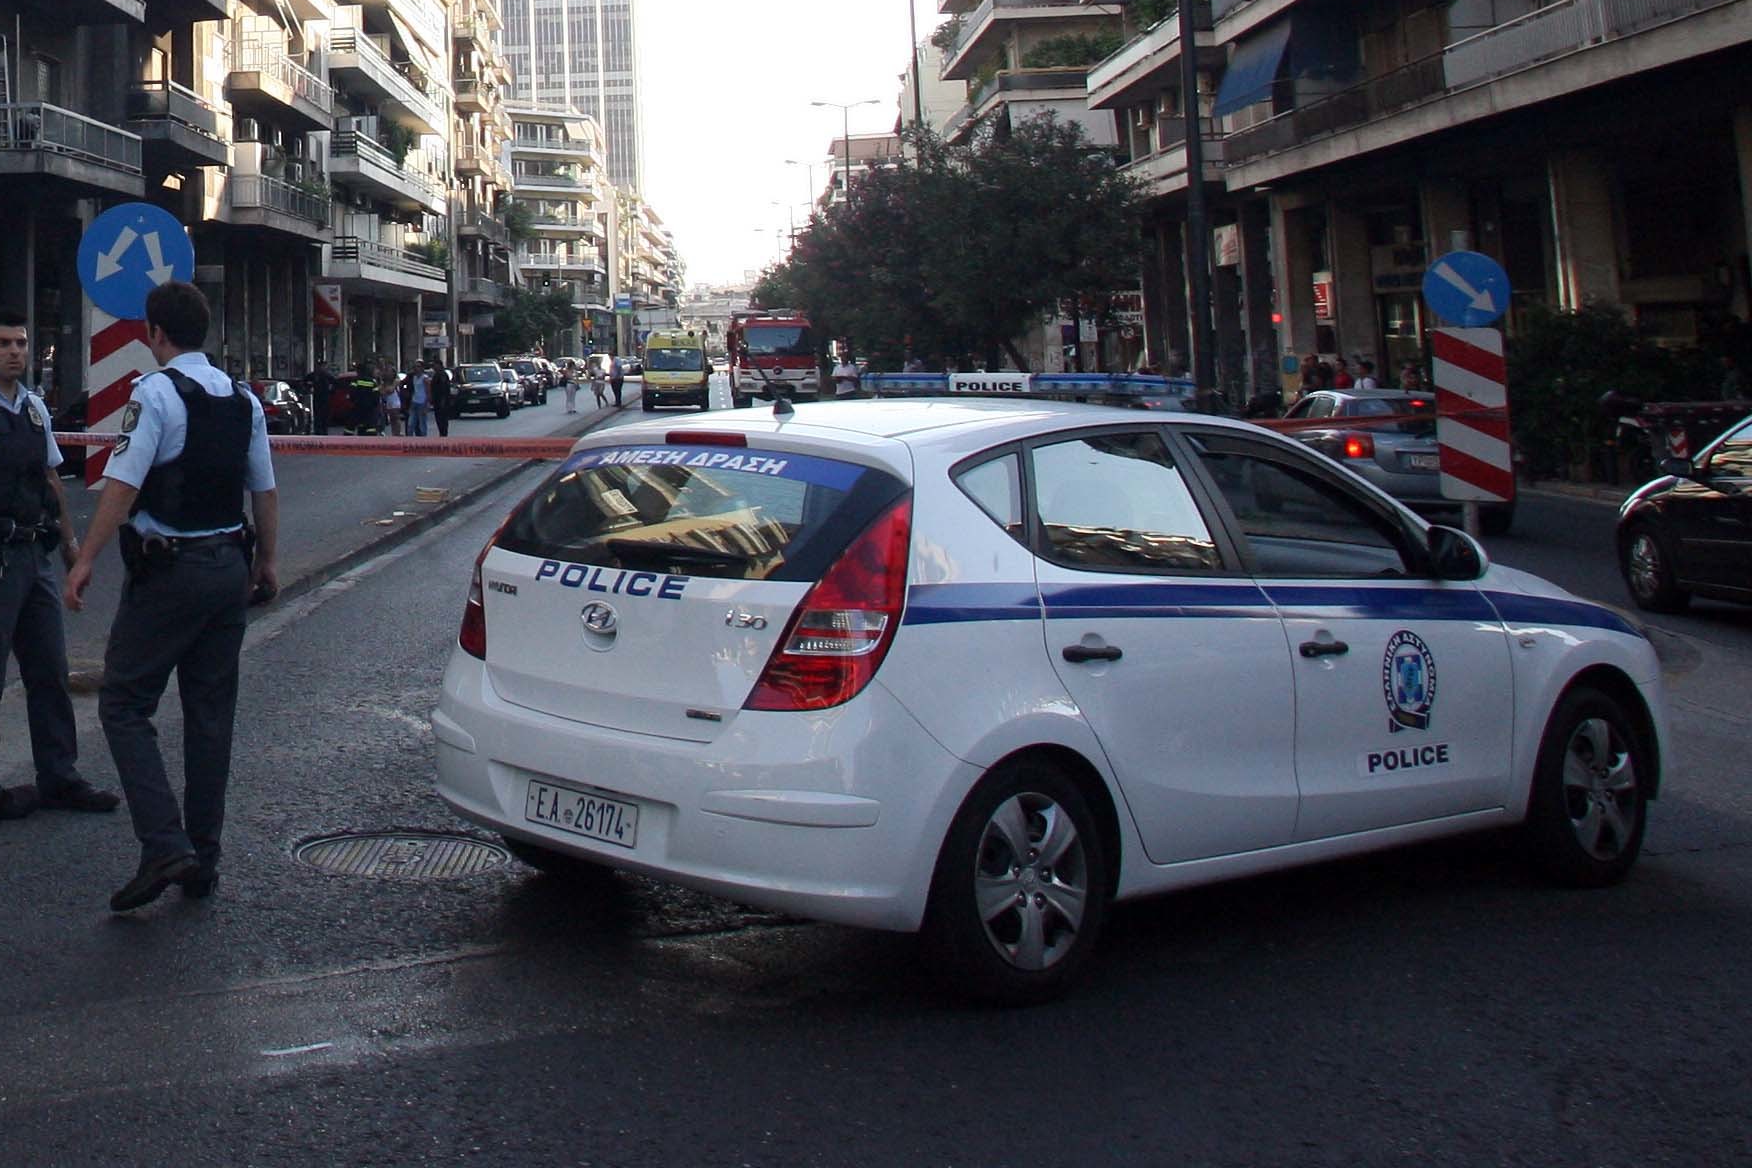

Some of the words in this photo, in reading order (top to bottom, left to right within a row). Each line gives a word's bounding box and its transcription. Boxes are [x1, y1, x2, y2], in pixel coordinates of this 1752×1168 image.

[954, 381, 1024, 393] POLICE
[685, 451, 788, 475] ΔΡΑΣΗ
[535, 559, 690, 600] POLICE
[725, 609, 768, 631] i30
[1367, 743, 1449, 774] POLICE
[574, 796, 624, 840] 26174
